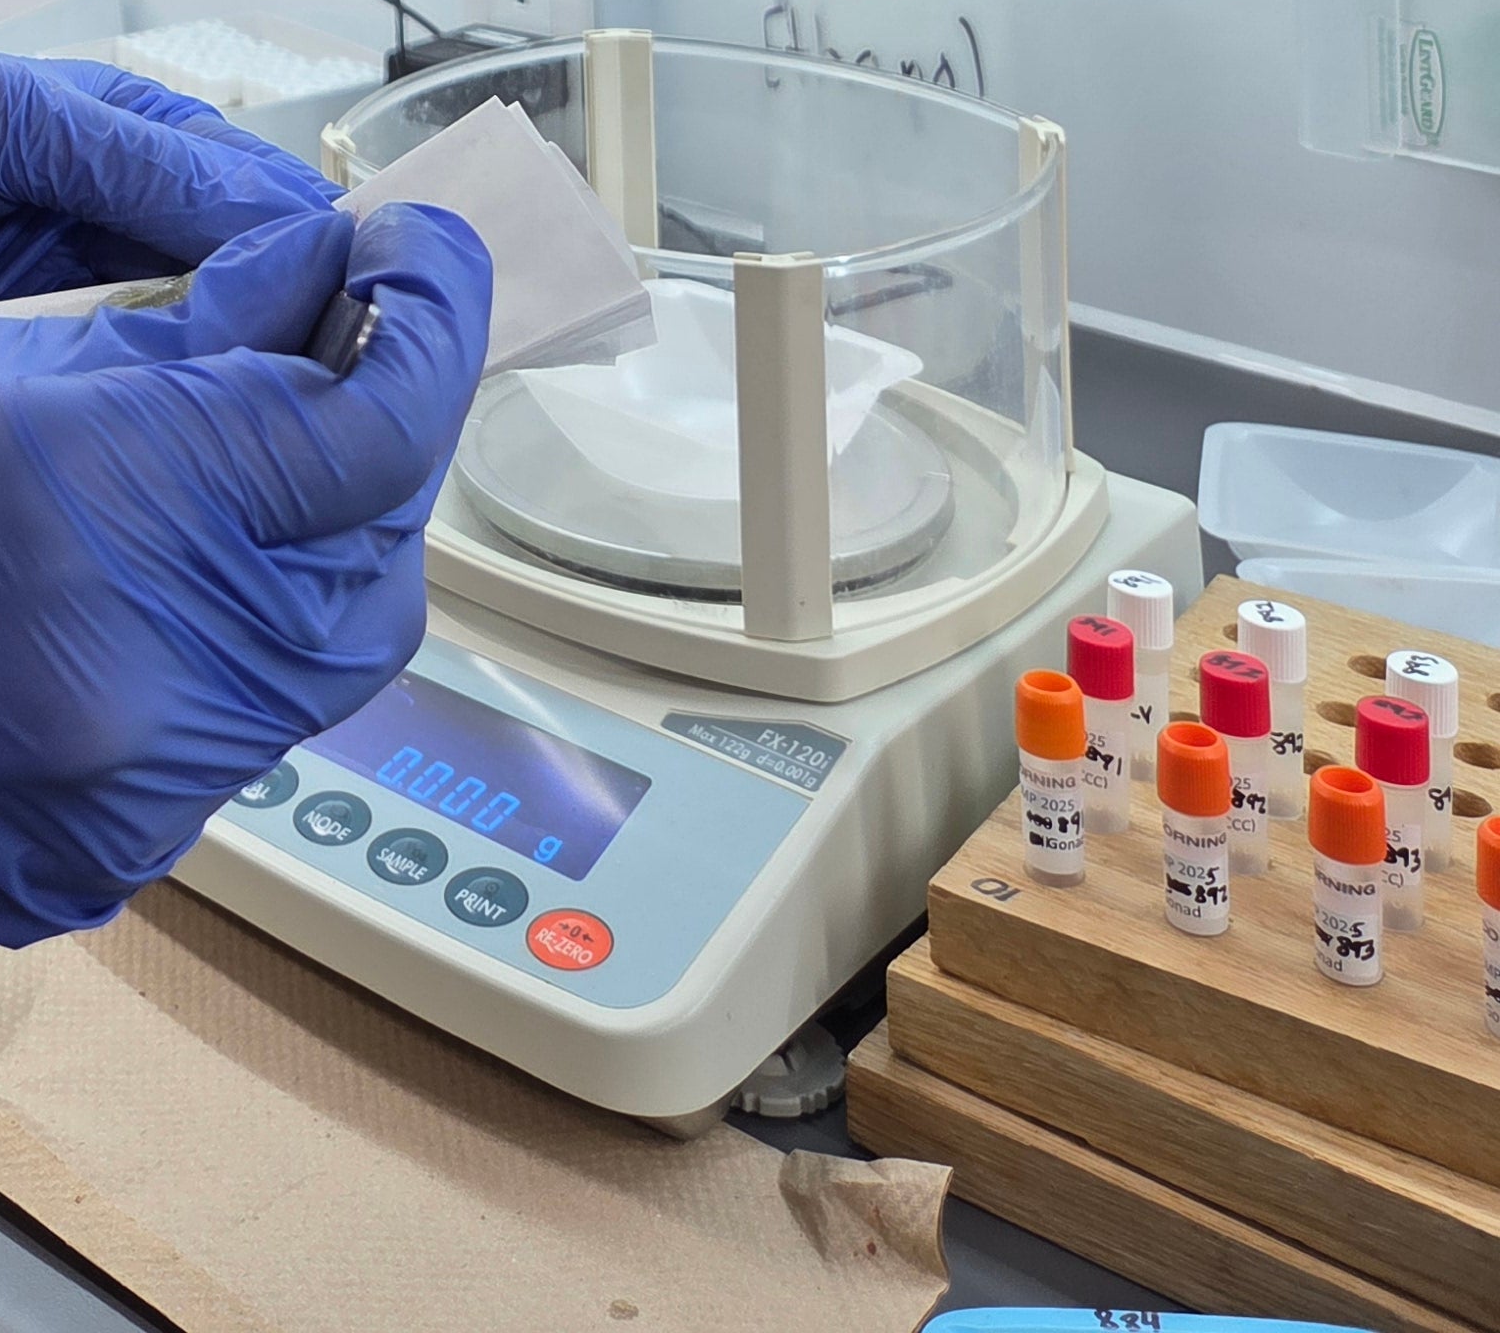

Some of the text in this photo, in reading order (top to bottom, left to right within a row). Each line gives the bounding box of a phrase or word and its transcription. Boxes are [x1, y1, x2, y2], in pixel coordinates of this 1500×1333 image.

[687, 724, 818, 789] Max 122g d=0.001g
[756, 729, 833, 770] FX-120i
[1085, 745, 1122, 776] 891
[376, 746, 563, 863] 0.000 g
[1040, 796, 1075, 813] 2025
[1231, 786, 1266, 814] 892
[302, 810, 352, 841] MODE
[377, 848, 428, 881] SAMPLE
[1315, 870, 1376, 896] RNING
[455, 889, 505, 921] PRINT
[534, 927, 593, 964] RE-ZERO
[1337, 936, 1375, 961] 893
[1094, 1310, 1161, 1332] 884
